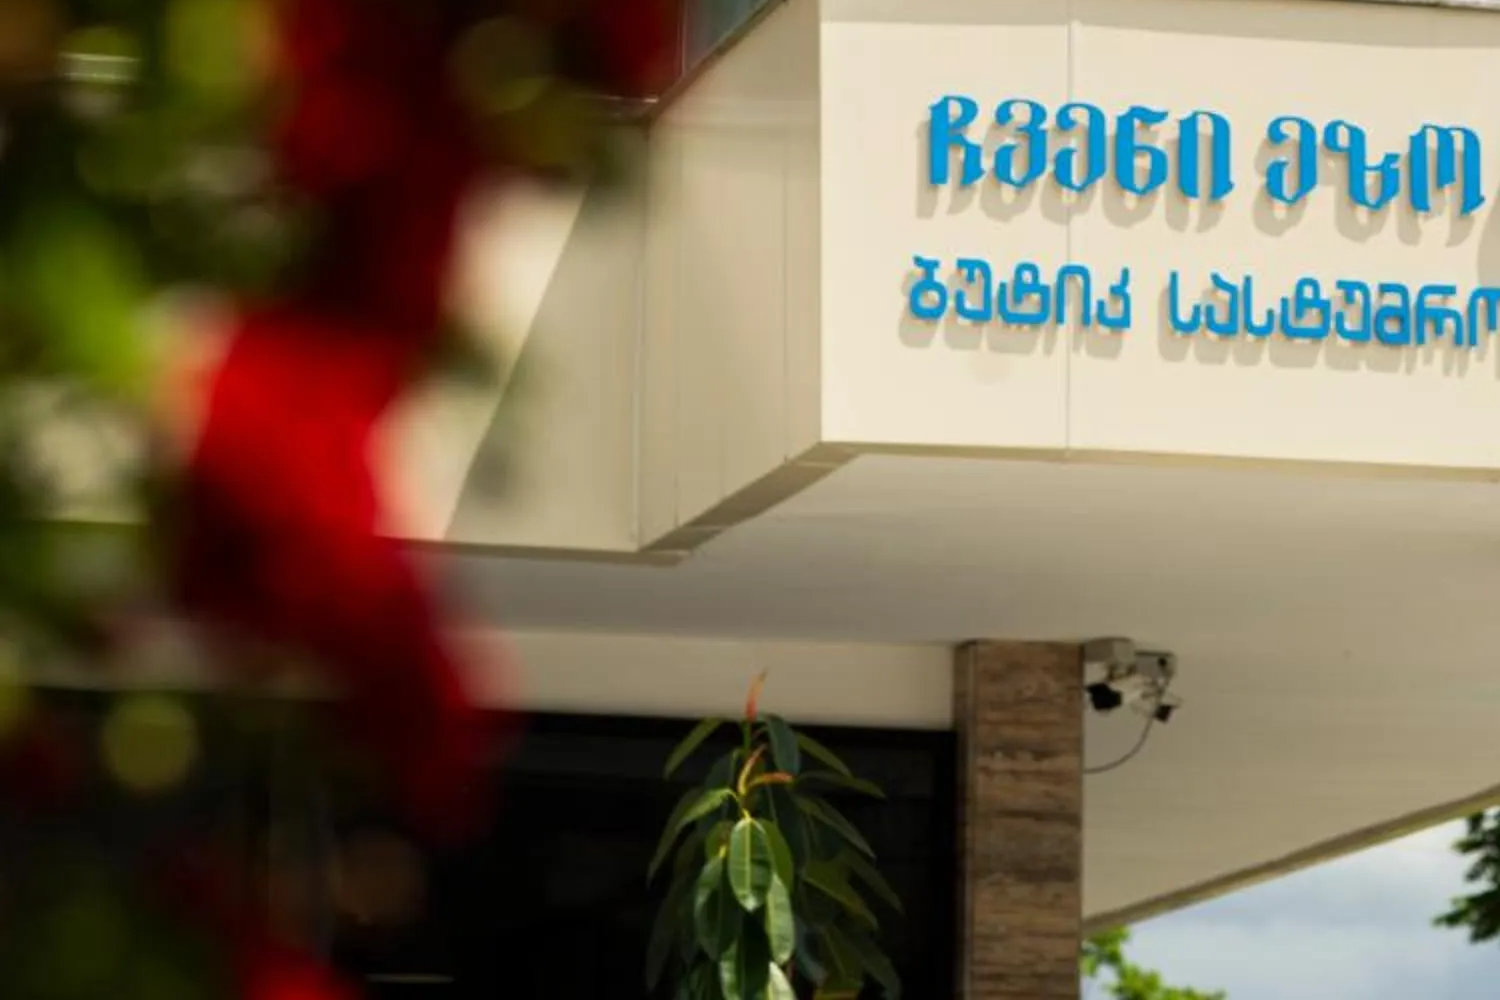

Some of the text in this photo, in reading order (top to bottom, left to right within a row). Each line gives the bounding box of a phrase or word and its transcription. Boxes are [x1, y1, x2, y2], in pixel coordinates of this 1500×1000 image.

[928, 95, 1486, 215] ჩვენი ეზო
[908, 255, 1132, 330] ბუტიკ
